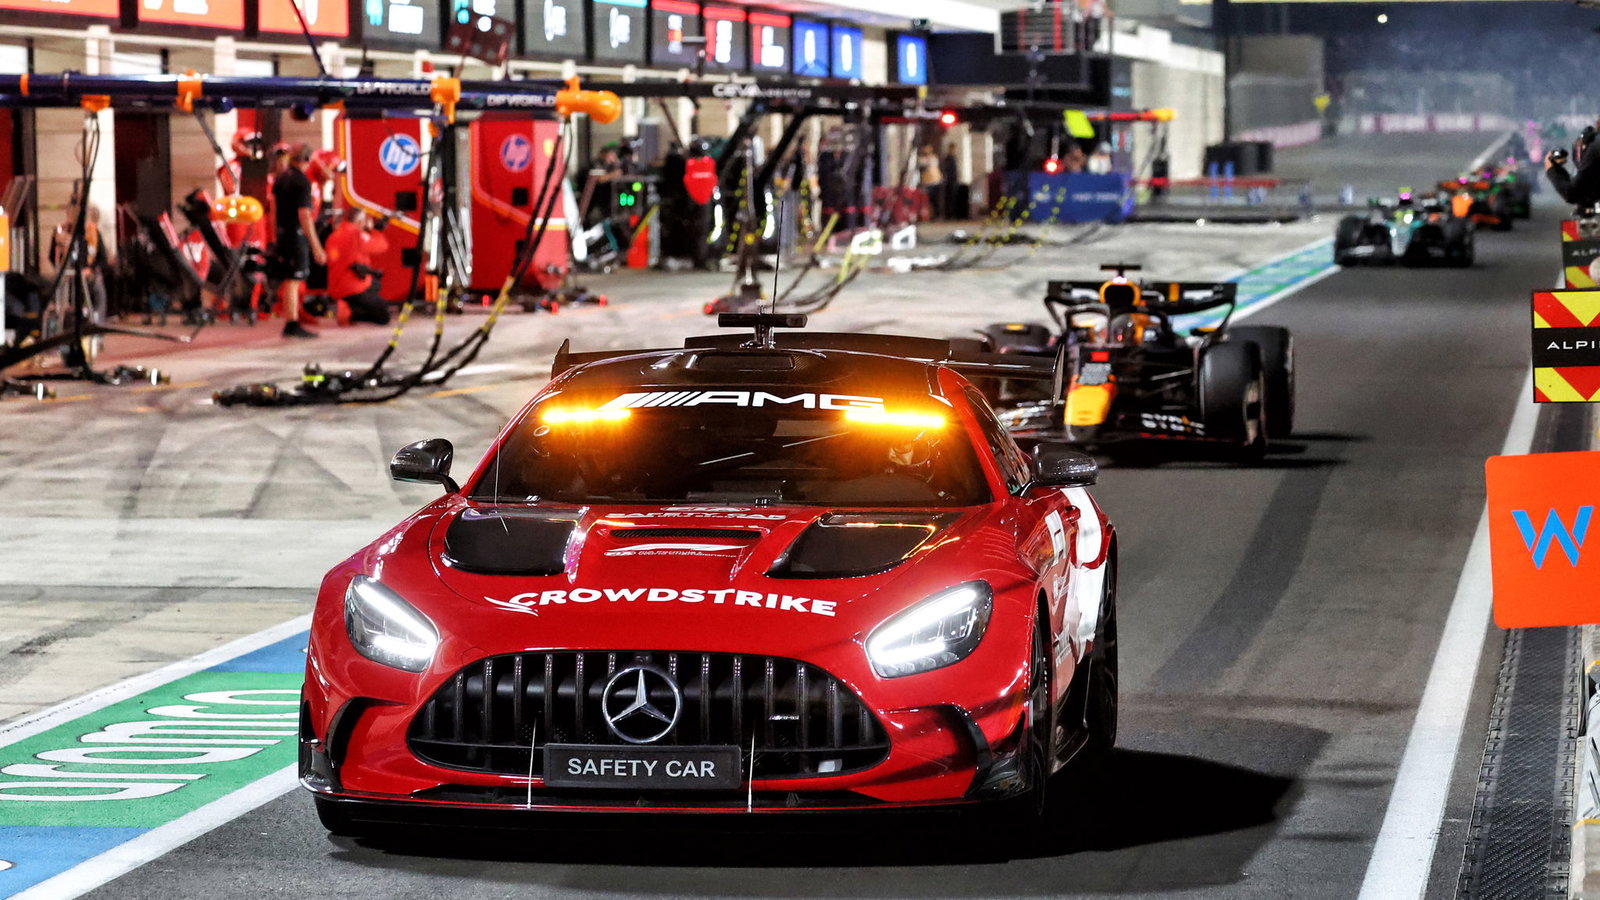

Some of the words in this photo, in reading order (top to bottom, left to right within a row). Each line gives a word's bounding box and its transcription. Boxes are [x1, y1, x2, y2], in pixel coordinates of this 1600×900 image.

[712, 83, 760, 97] CEVA
[1547, 340, 1600, 350] ALPI
[508, 588, 837, 616] CROWDSTRIKE
[568, 758, 657, 776] SAFETY
[665, 760, 715, 778] CAR
